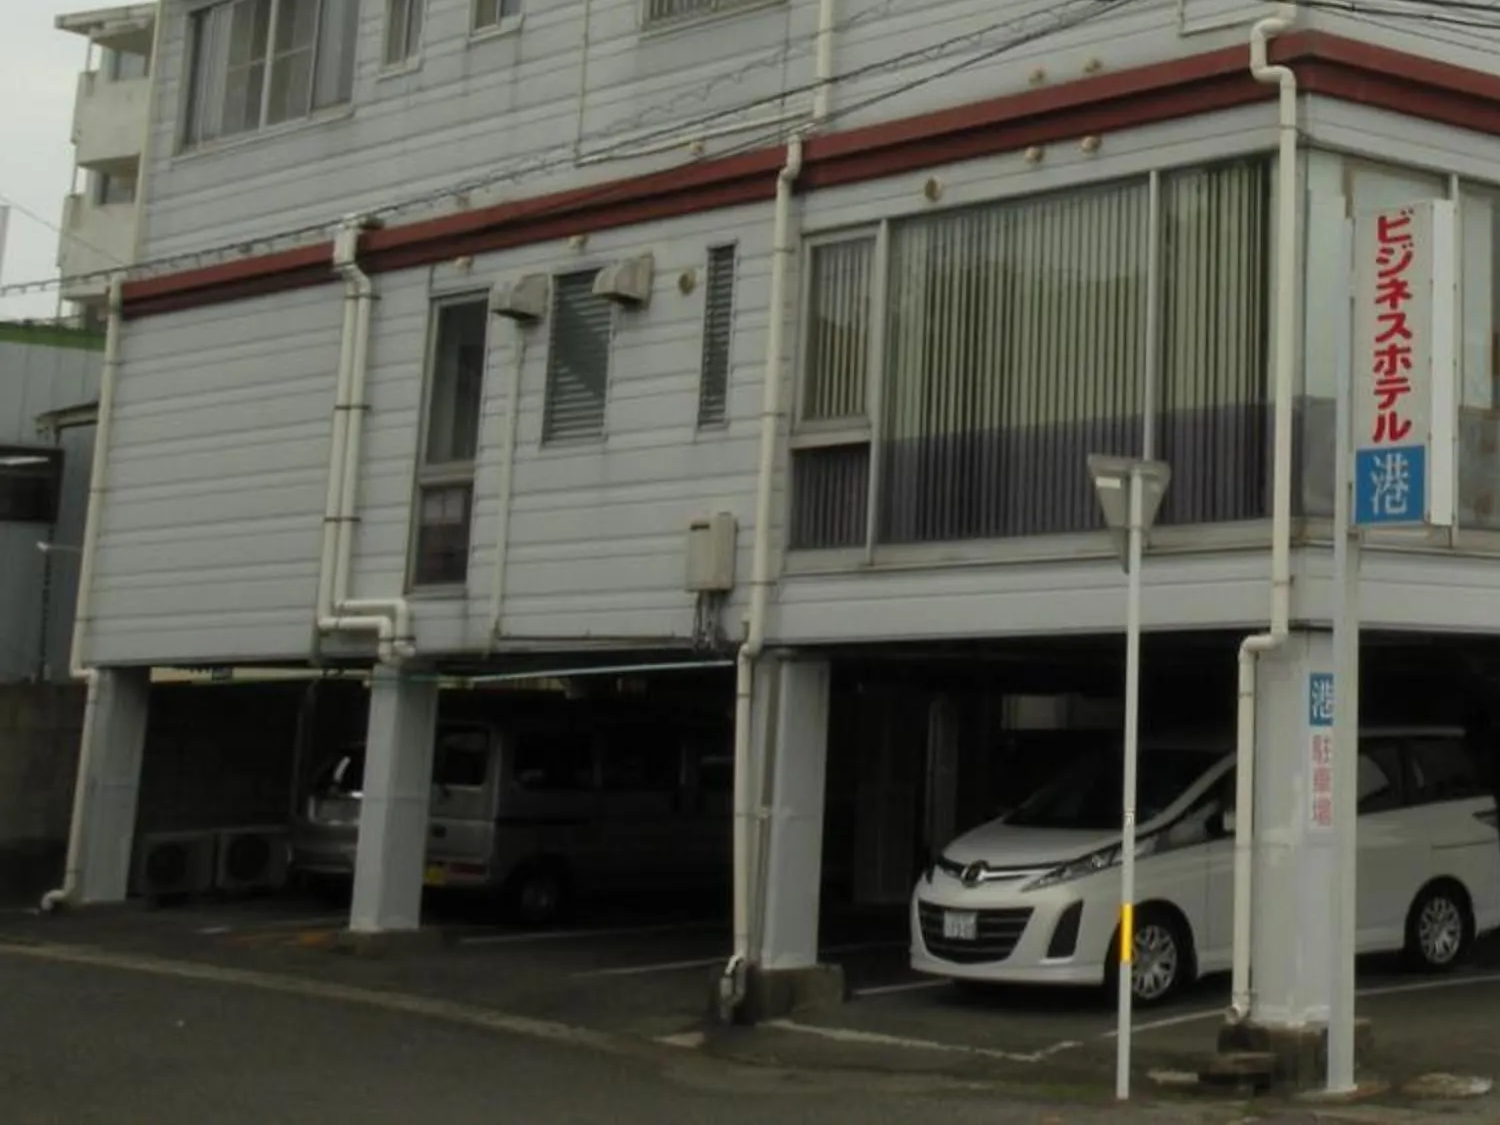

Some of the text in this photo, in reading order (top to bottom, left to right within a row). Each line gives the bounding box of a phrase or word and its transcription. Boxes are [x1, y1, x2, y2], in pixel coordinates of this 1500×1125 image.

[1373, 209, 1414, 443] ビジネスホテル
[1371, 453, 1409, 514] 港
